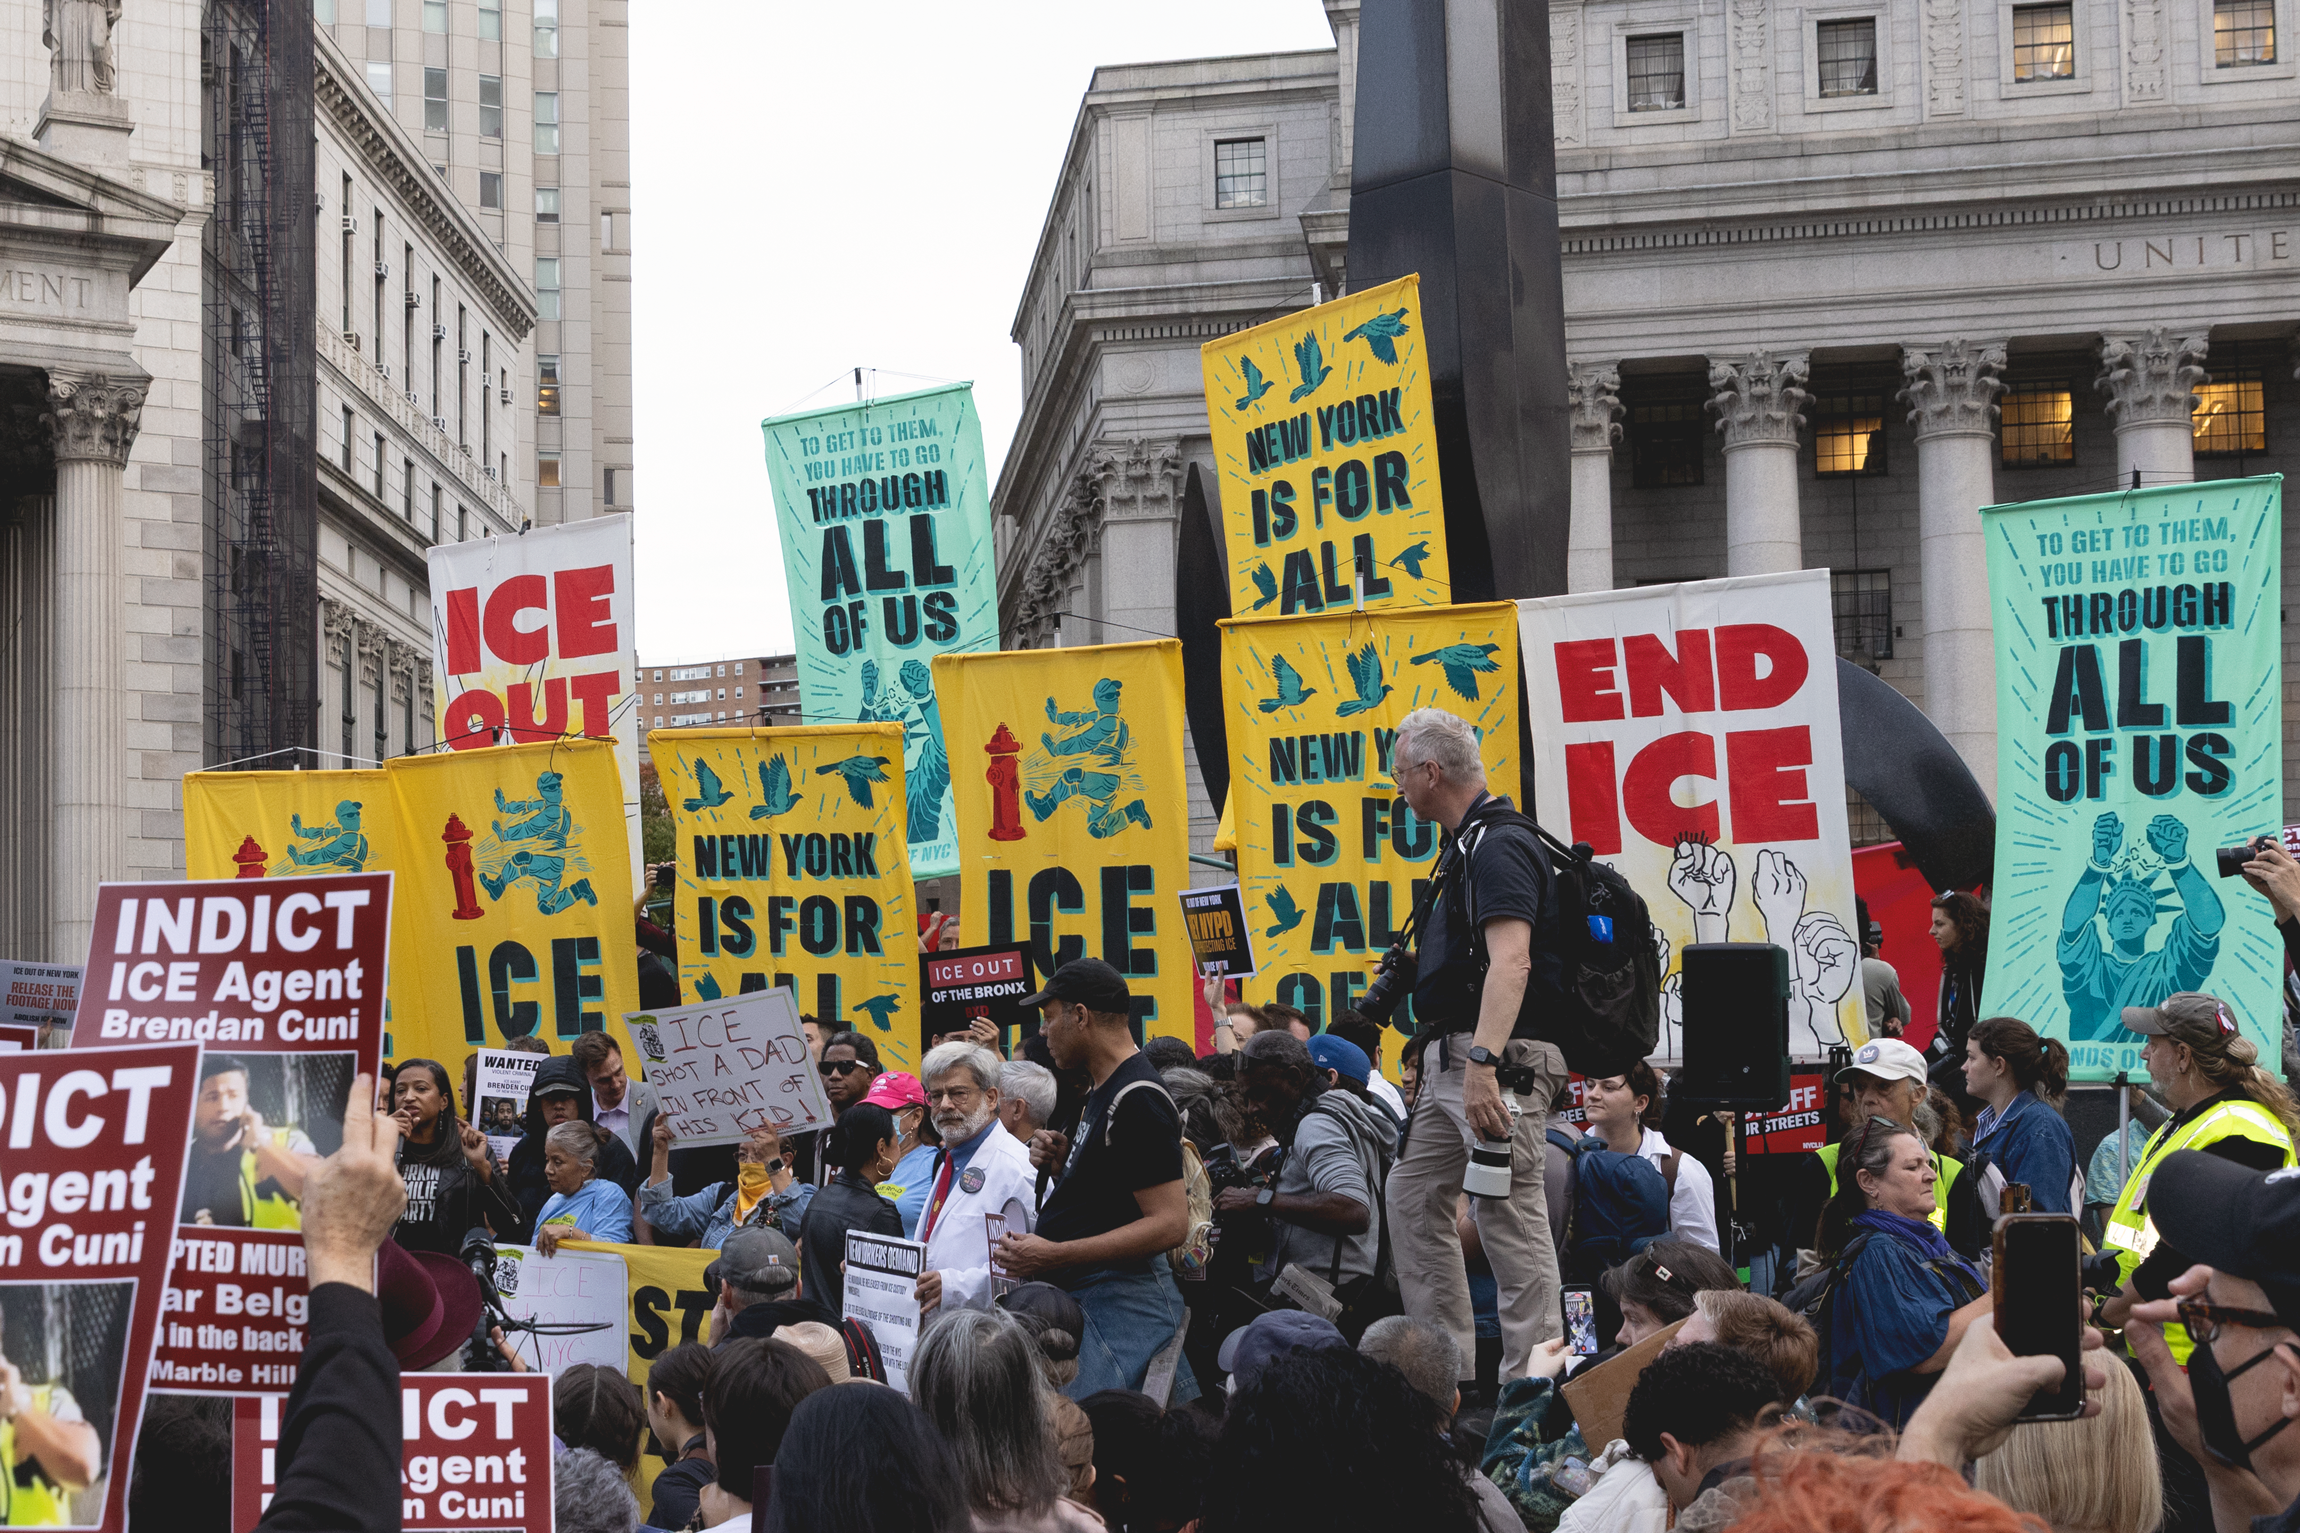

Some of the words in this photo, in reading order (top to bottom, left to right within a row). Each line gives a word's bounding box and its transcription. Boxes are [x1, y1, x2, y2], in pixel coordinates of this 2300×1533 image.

[2095, 231, 2290, 270] UNITE
[800, 436, 820, 457] TO
[826, 430, 855, 453] GET
[860, 426, 882, 446] TO
[887, 418, 944, 443] THEM,
[1245, 412, 1311, 476] NEW
[1316, 386, 1407, 451] YORK
[804, 460, 836, 482] YOU
[842, 452, 885, 477] HAVE
[890, 448, 910, 469] TO
[916, 443, 941, 465] GO
[807, 469, 951, 525] THROUGH
[1250, 479, 1298, 548] IS
[1312, 450, 1413, 530] FOR
[2036, 532, 2063, 557] TO
[2072, 528, 2114, 554] GET
[2122, 524, 2150, 549] TO
[2159, 516, 2237, 545] THEM,
[821, 514, 958, 604] ALL
[1280, 532, 1393, 616] ALL
[2039, 562, 2082, 587] YOU
[2091, 555, 2150, 583] HAVE
[2158, 552, 2185, 576] TO
[2194, 549, 2228, 573] GO
[446, 563, 618, 676] ICE
[823, 600, 870, 659] OF
[883, 591, 961, 650] US
[2041, 582, 2236, 642] THROUGH
[1554, 623, 1809, 723] END
[2045, 635, 2236, 738] ALL
[444, 669, 620, 751] OUT
[1269, 731, 1366, 786] NEW
[2044, 737, 2117, 805] OF
[2133, 732, 2236, 800] US
[1564, 725, 1819, 856] ICE
[921, 843, 951, 862] NYC
[1272, 800, 1339, 868] IS
[1361, 797, 1438, 864] FO
[694, 833, 772, 881] NEW
[780, 832, 881, 881] YORK
[114, 889, 370, 954] INDICT
[698, 895, 757, 959] IS
[768, 895, 885, 959] FOR
[988, 865, 1158, 980] ICE
[1199, 910, 1233, 940] NYPD
[1226, 938, 1237, 951] ICE
[11, 981, 54, 997] RELEASE
[57, 985, 75, 998] THE
[13, 966, 24, 976] ICE
[24, 967, 37, 976] OUT
[37, 968, 46, 977] OF
[46, 969, 61, 978] NEW
[62, 970, 80, 980] YORK
[108, 961, 200, 1001] ICE
[212, 957, 364, 1012] Agent
[935, 965, 964, 981] ICE
[972, 958, 1013, 977] OUT
[6, 994, 50, 1010] FOOTAGE
[52, 999, 79, 1012] NOW
[456, 936, 606, 1046] ICE
[931, 991, 948, 1004] OF
[948, 988, 973, 1001] THE
[974, 981, 1027, 999] BRONX
[964, 1004, 990, 1018] BXD
[13, 1013, 40, 1022] ABOLISH
[101, 1008, 265, 1041] Brendan
[277, 1008, 359, 1041] Cuni
[669, 1010, 751, 1053] ICE
[484, 1055, 541, 1072] WANTED
[512, 1070, 533, 1078] CRIMINAL
[651, 1061, 700, 1087] SHOT
[714, 1053, 733, 1077] A
[737, 1034, 807, 1070] DAD
[2066, 1047, 2115, 1069] NDS
[487, 1082, 519, 1091] BRENDEN
[661, 1095, 688, 1116] IN
[692, 1079, 764, 1109] FRONT
[778, 1074, 805, 1093] OF
[0, 1066, 172, 1149] ICT
[676, 1117, 719, 1137] HIS
[1765, 1111, 1820, 1133] STREETS
[1802, 1141, 1824, 1150] NYCLU
[0, 1155, 155, 1228] gent
[400, 1200, 436, 1221] ARTY
[38, 1220, 146, 1267] Cuni
[887, 1246, 918, 1274] DEMAND
[1290, 1282, 1311, 1301] Times
[169, 1322, 193, 1348] in
[197, 1324, 238, 1351] the
[242, 1326, 304, 1353] back
[533, 1337, 585, 1371] NYC
[150, 1360, 243, 1383] Marble
[251, 1364, 297, 1385] Hill
[402, 1447, 526, 1494] gent
[438, 1490, 525, 1519] Cuni
